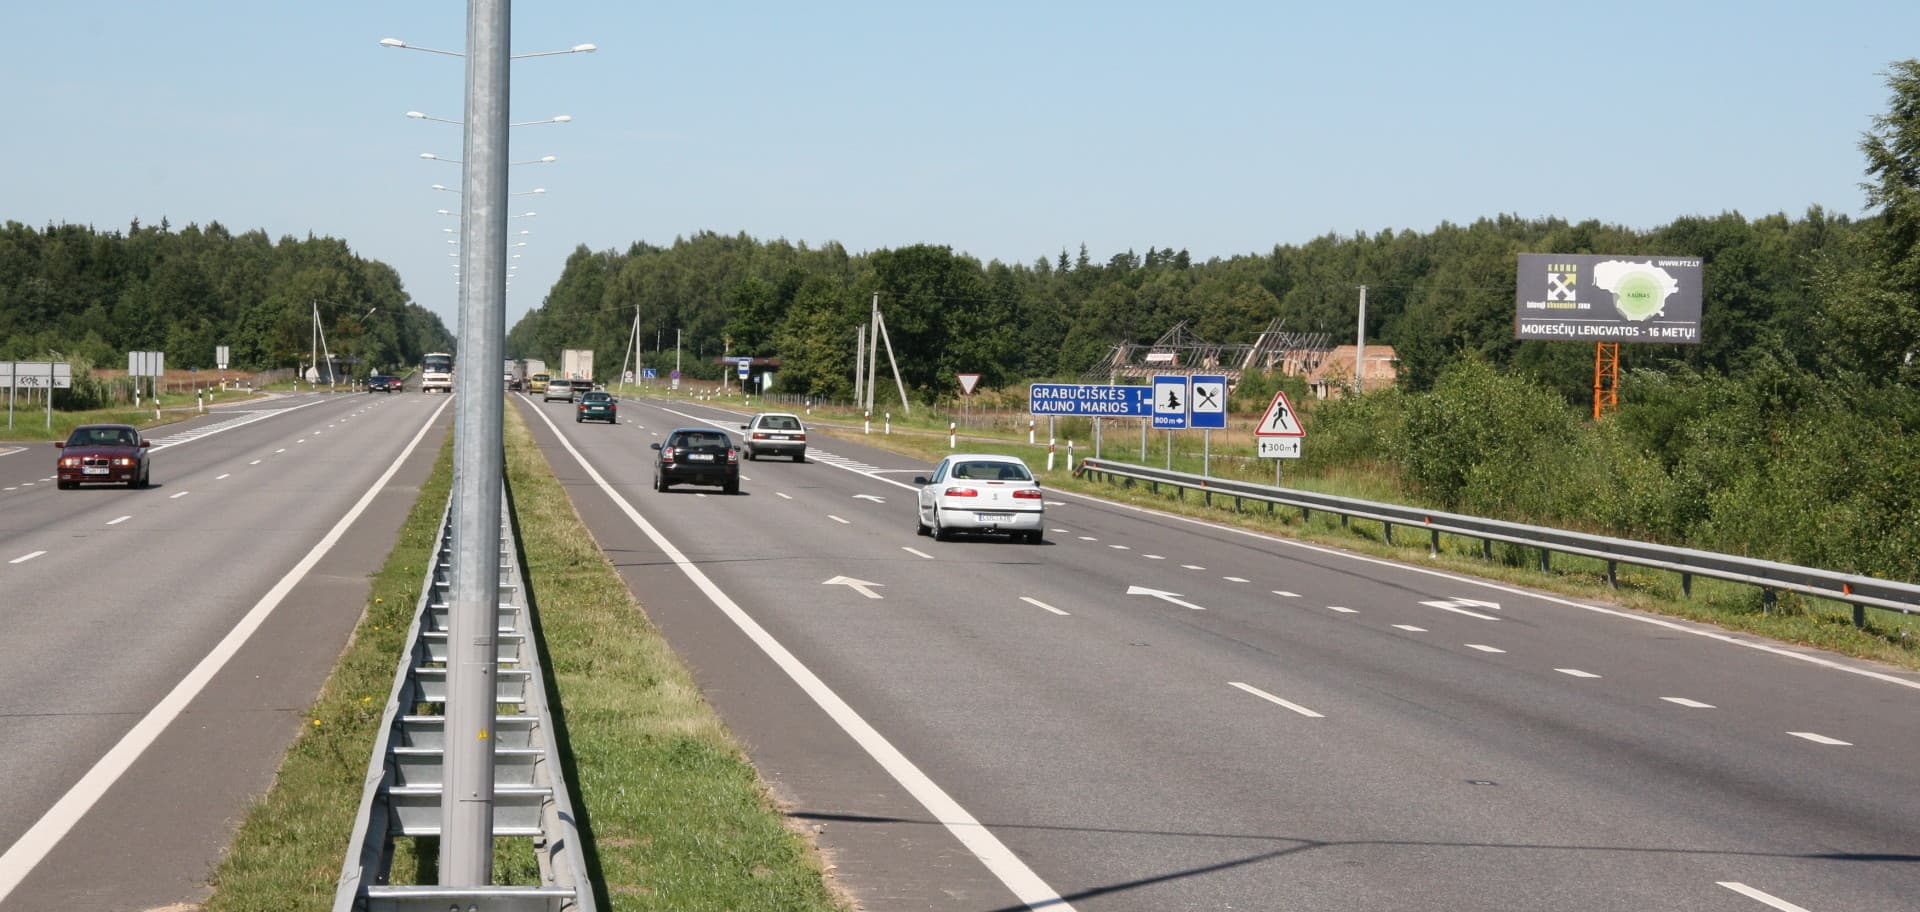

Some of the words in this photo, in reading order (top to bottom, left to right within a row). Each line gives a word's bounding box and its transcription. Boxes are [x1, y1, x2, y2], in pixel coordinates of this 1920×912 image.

[1521, 323, 1576, 337] MOKESČIŲ
[1578, 325, 1640, 337] LENGVATOS
[1648, 327, 1659, 337] 16
[1662, 328, 1696, 340] METŲ!
[1033, 385, 1126, 400] GRABUČIŠKĖS
[1136, 389, 1142, 401] 1
[1033, 401, 1075, 412] KAUNO
[1081, 401, 1129, 413] MARIOS
[1137, 403, 1142, 414] 1
